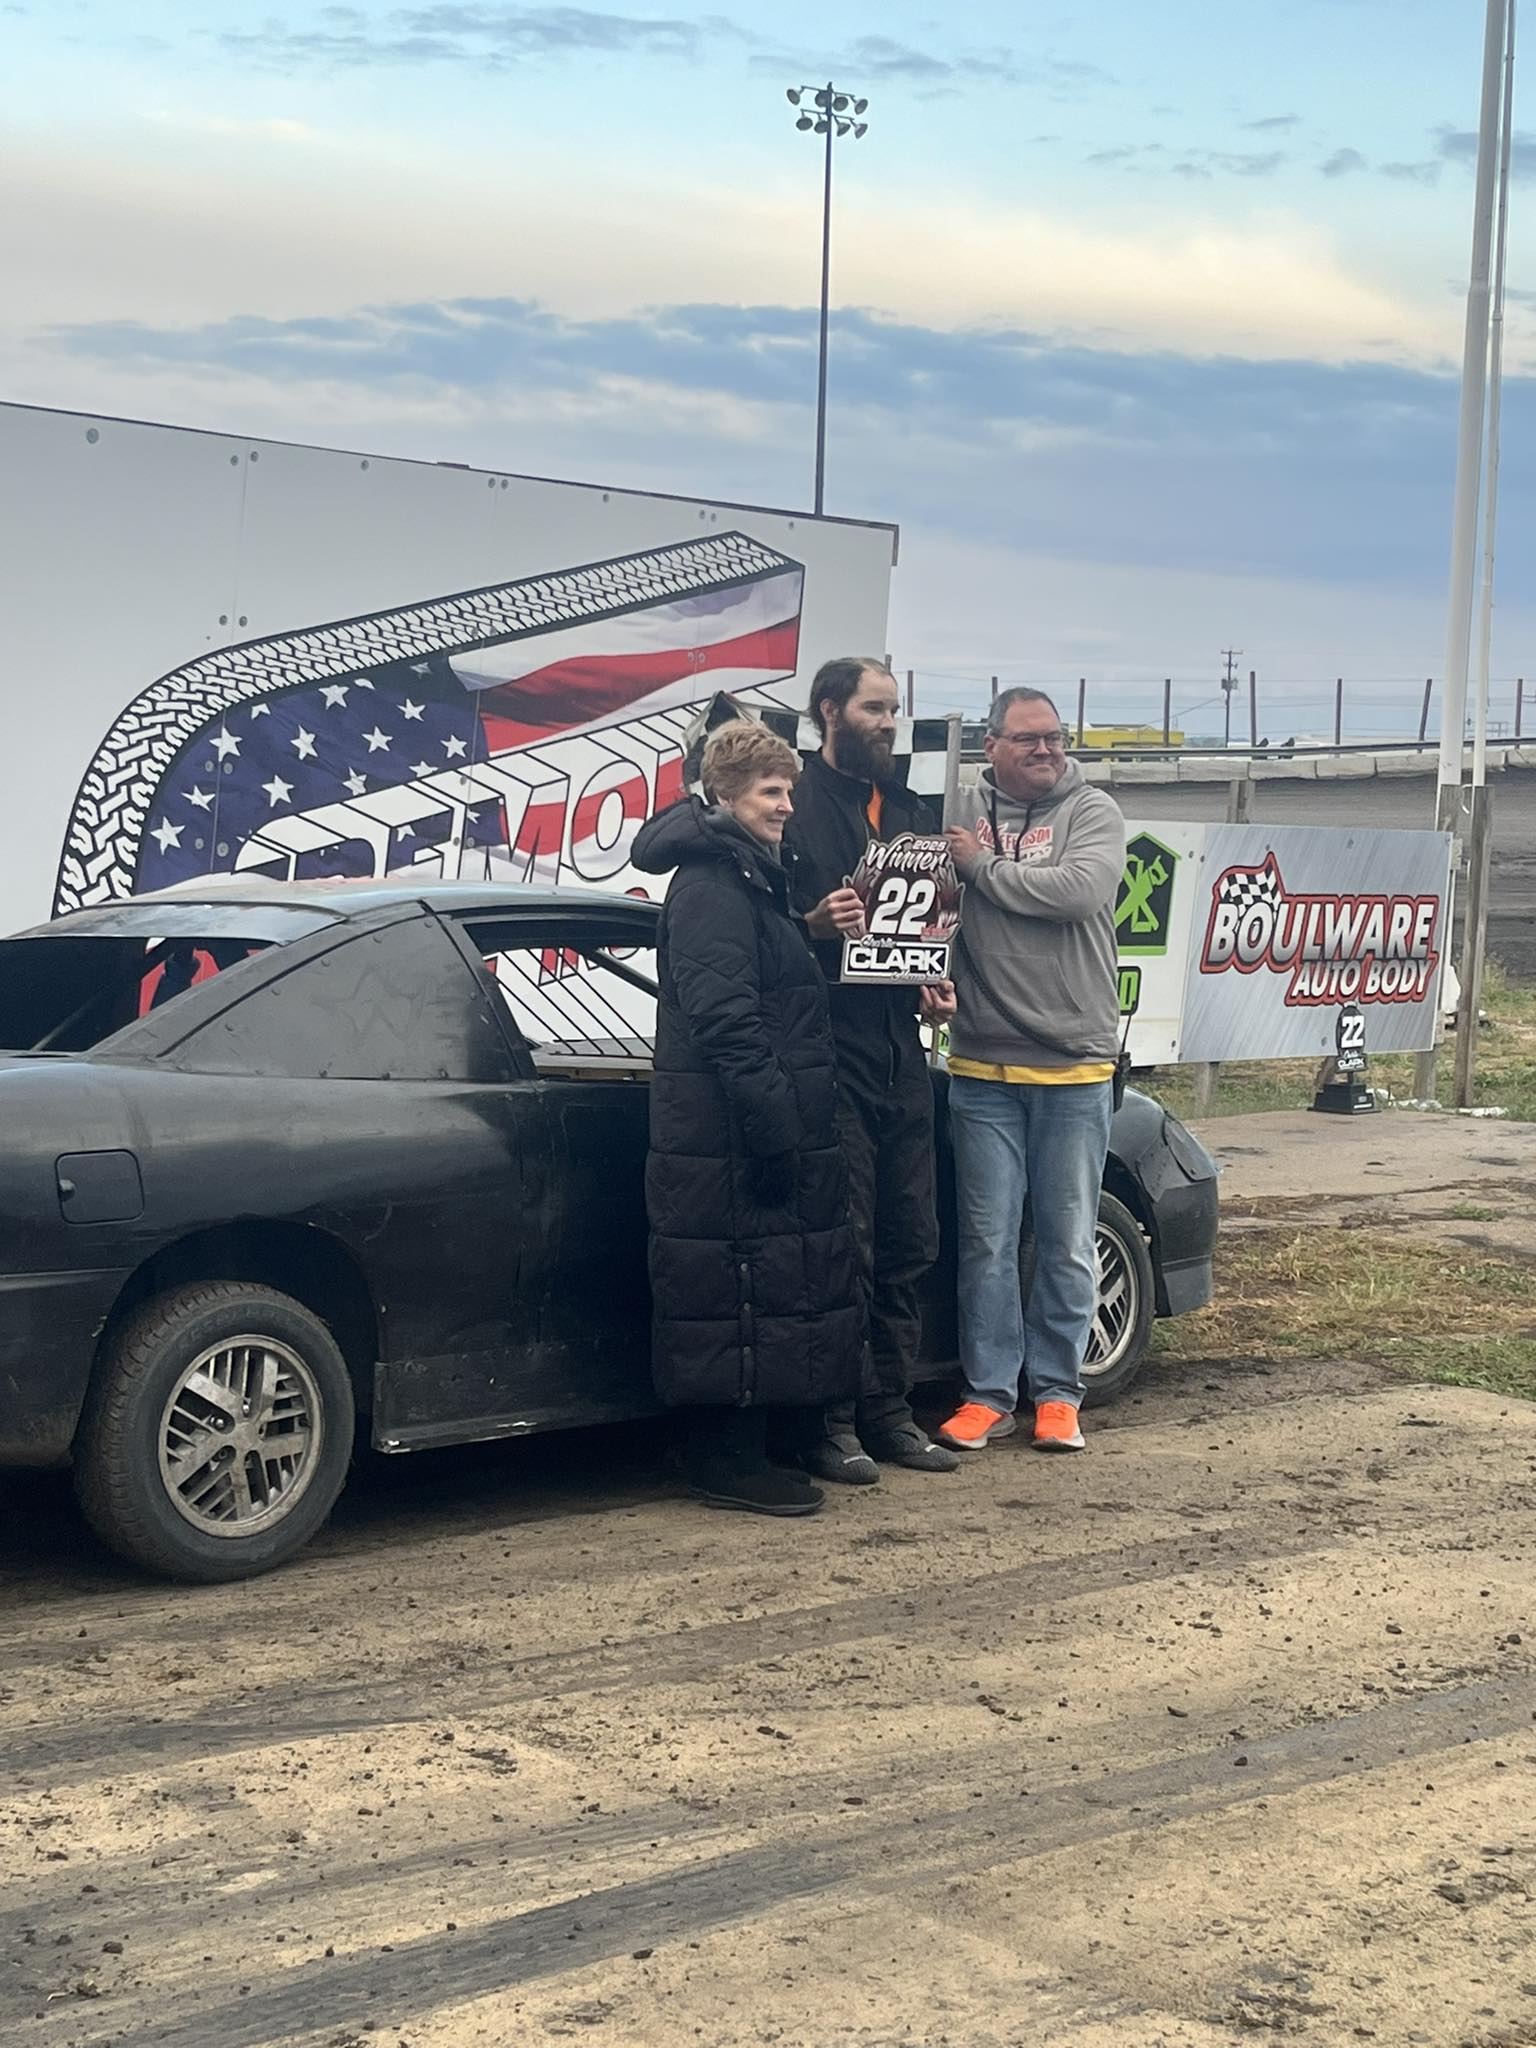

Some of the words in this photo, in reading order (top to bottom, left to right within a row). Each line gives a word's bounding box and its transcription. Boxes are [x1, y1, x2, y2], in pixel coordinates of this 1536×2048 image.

[867, 836, 947, 873] Winner
[912, 840, 947, 851] 2025
[870, 877, 936, 935] 22
[1207, 901, 1435, 963] BOULWARE
[849, 947, 945, 971] CLARK
[1291, 960, 1361, 997] AUTO
[1365, 959, 1432, 996] BODY
[1341, 1014, 1365, 1049] 22
